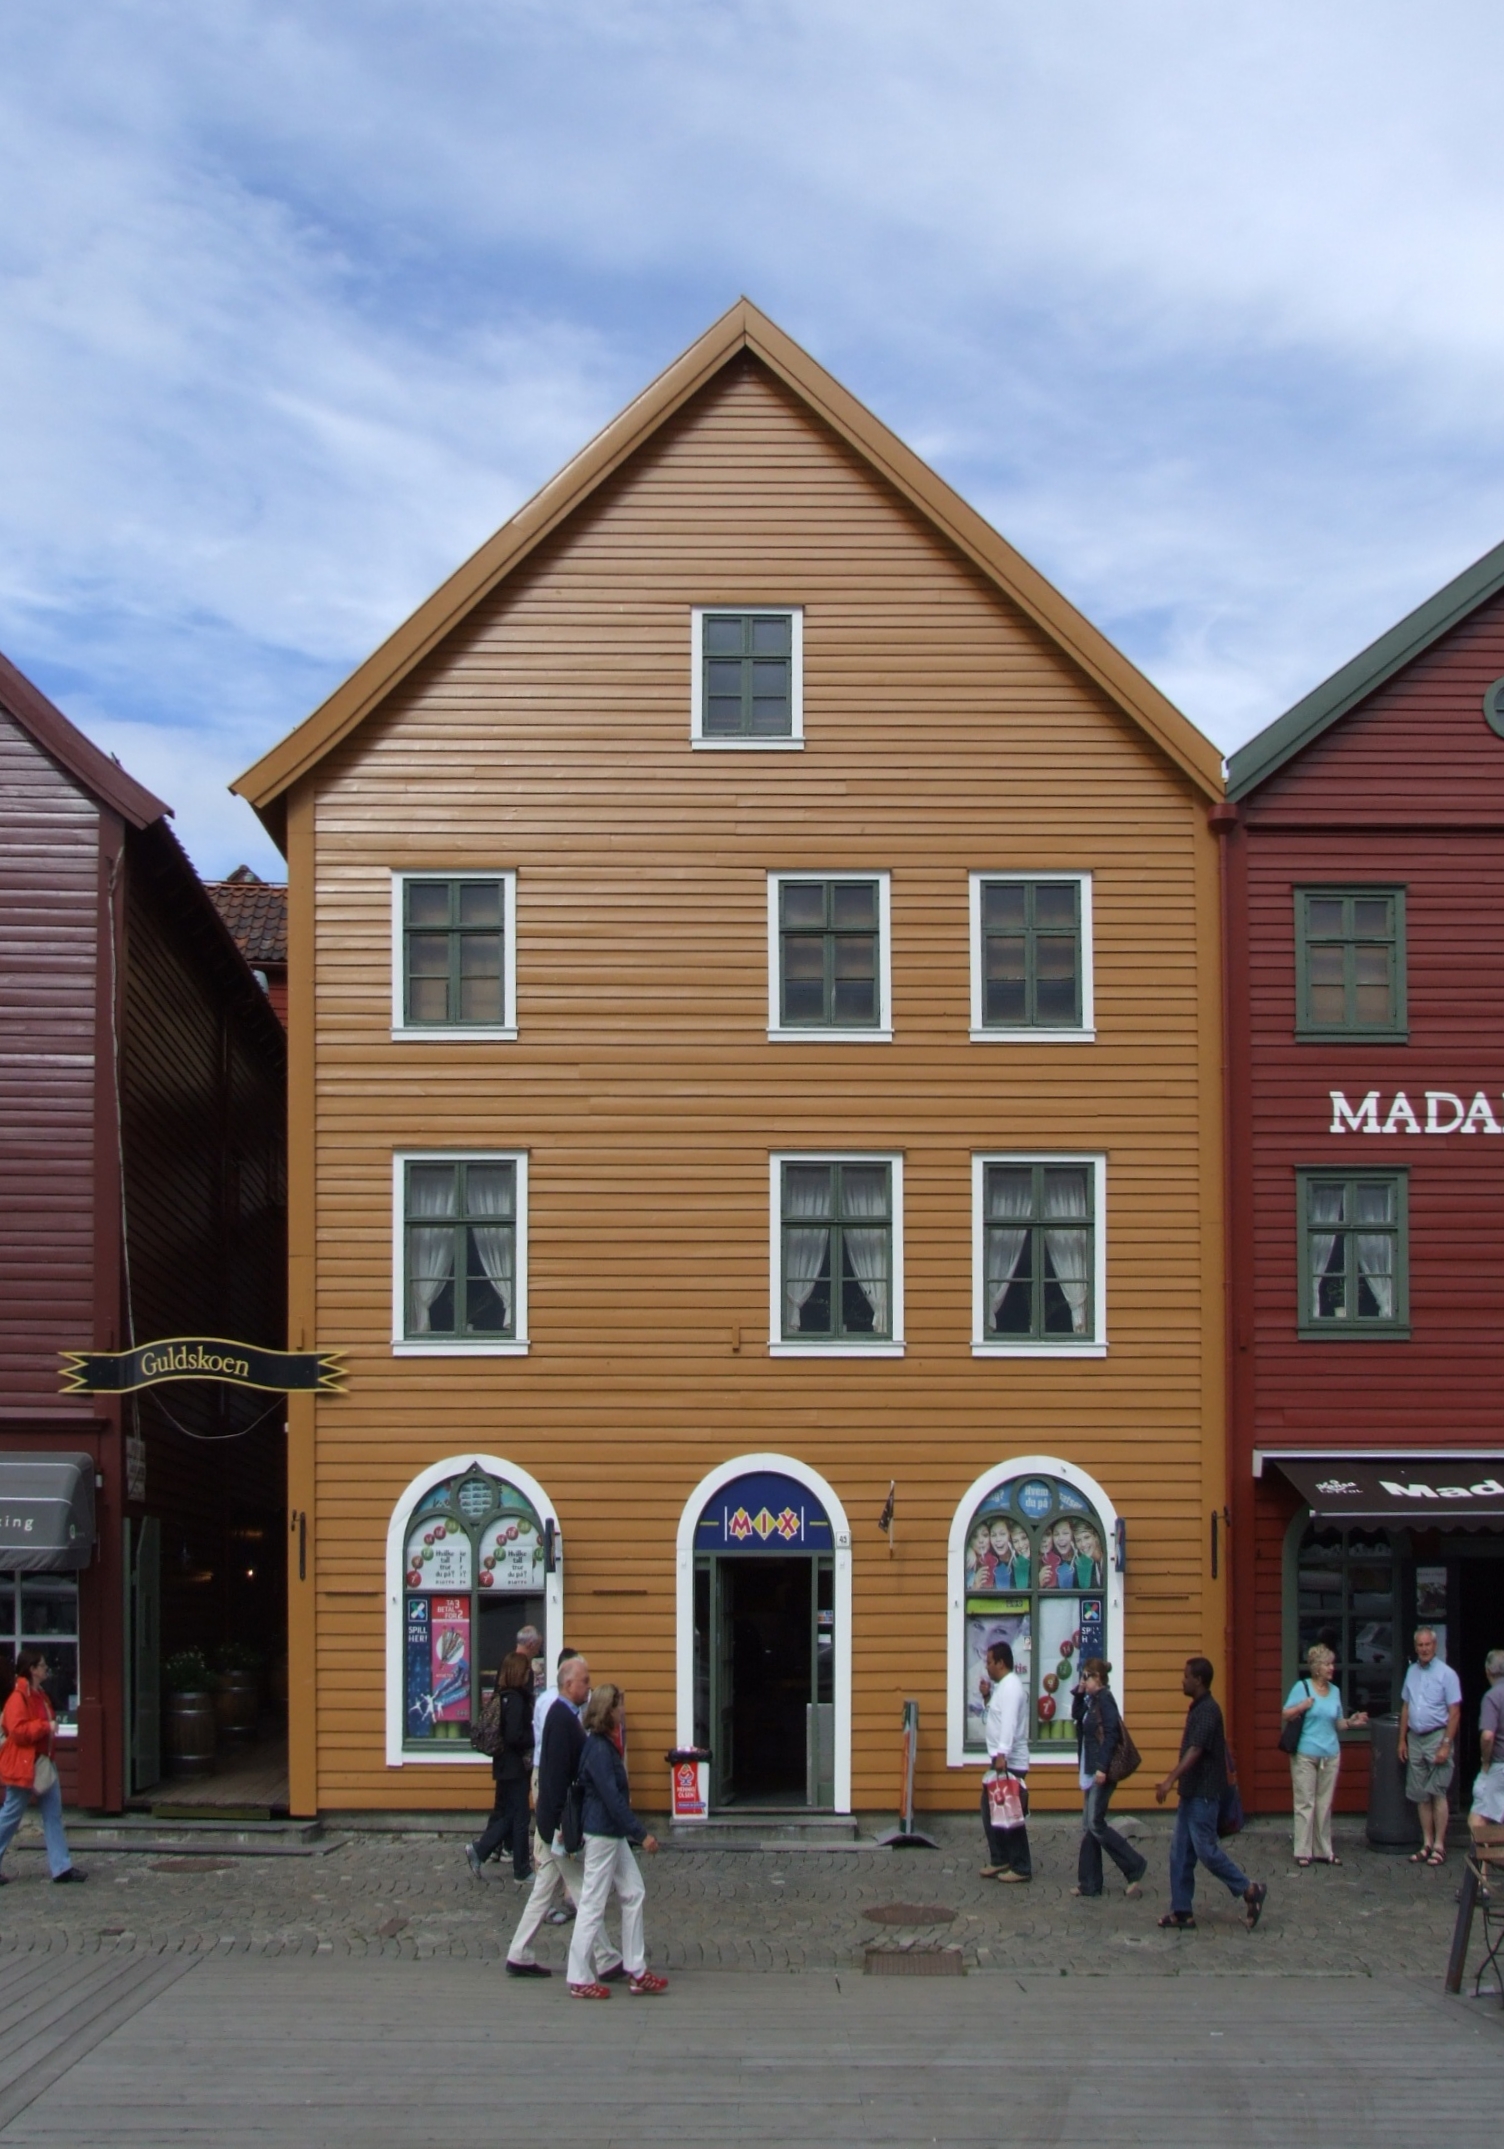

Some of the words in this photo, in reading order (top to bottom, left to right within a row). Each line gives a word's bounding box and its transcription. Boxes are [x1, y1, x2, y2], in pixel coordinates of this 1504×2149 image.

[1329, 1091, 1504, 1133] MADA
[141, 1346, 249, 1377] Guldskoen
[730, 1511, 797, 1536] MIX
[455, 1599, 460, 1609] 3
[458, 1610, 463, 1619] 2
[408, 1626, 427, 1634] SPILL
